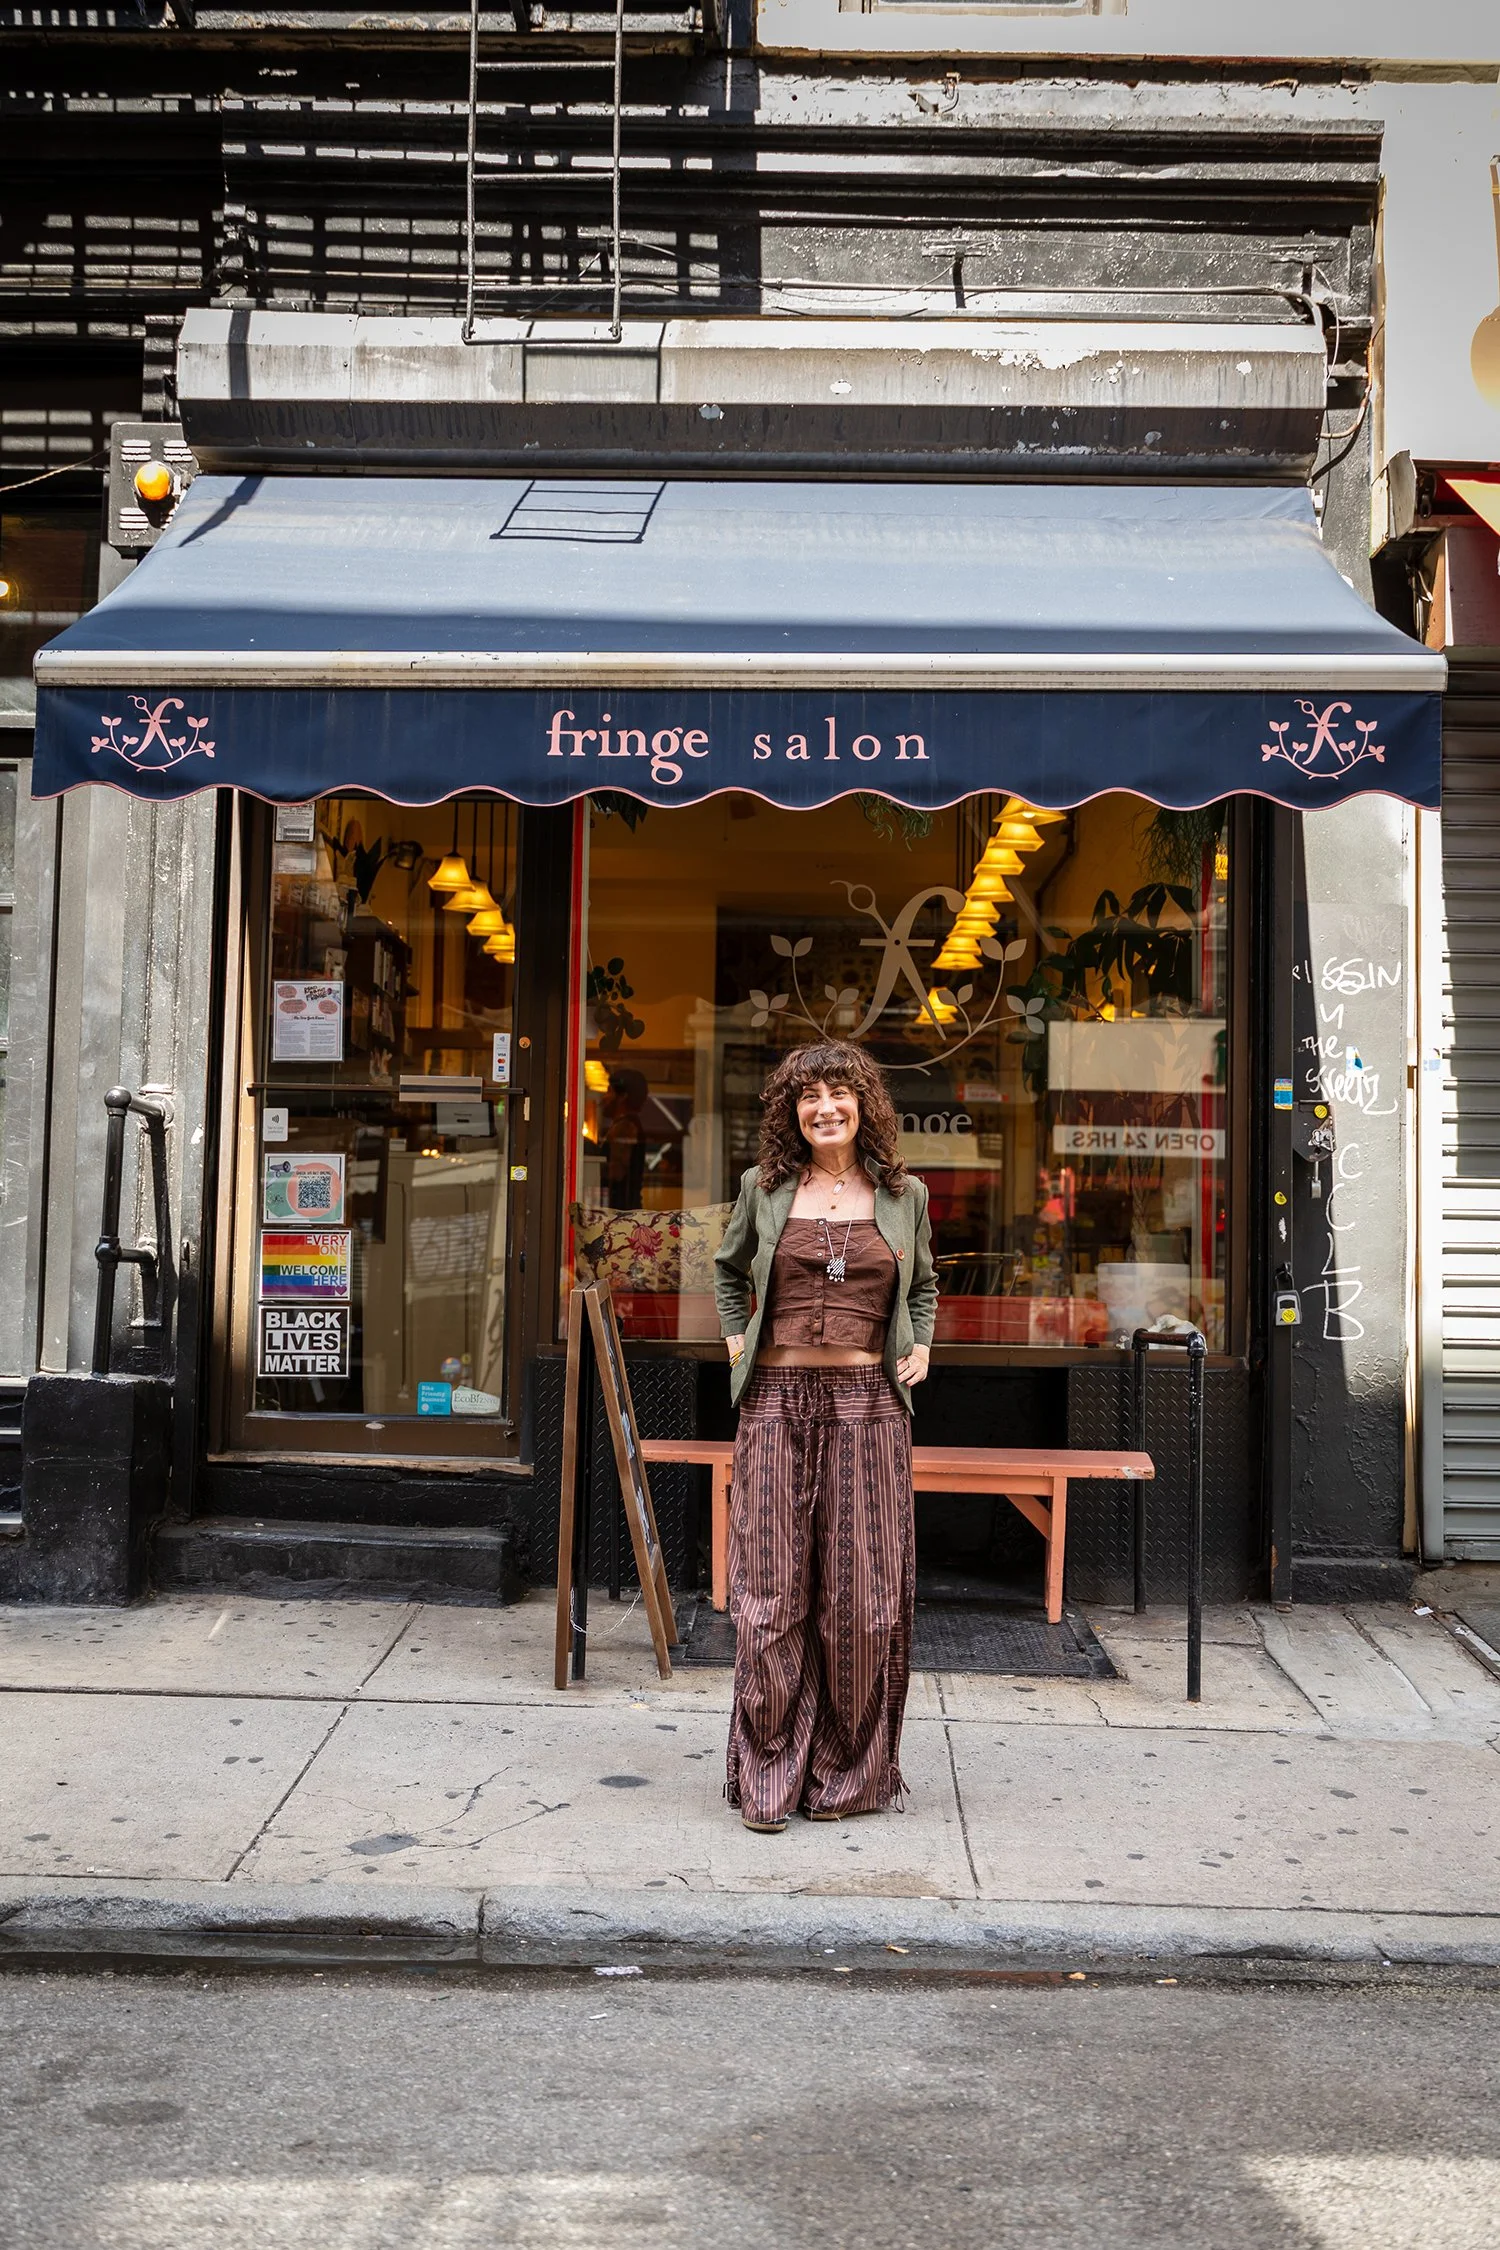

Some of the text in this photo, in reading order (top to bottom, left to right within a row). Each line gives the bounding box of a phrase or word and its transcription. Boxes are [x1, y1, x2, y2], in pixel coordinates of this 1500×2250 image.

[546, 709, 930, 785] fringe salon
[896, 1111, 973, 1160] nge
[305, 1235, 347, 1246] EVERY
[320, 1245, 347, 1256] ONE
[281, 1265, 347, 1276] WELCOME
[313, 1275, 347, 1286] HERE
[265, 1311, 342, 1329] BLACK
[267, 1332, 339, 1351] LIVES
[265, 1354, 341, 1373] MATTER
